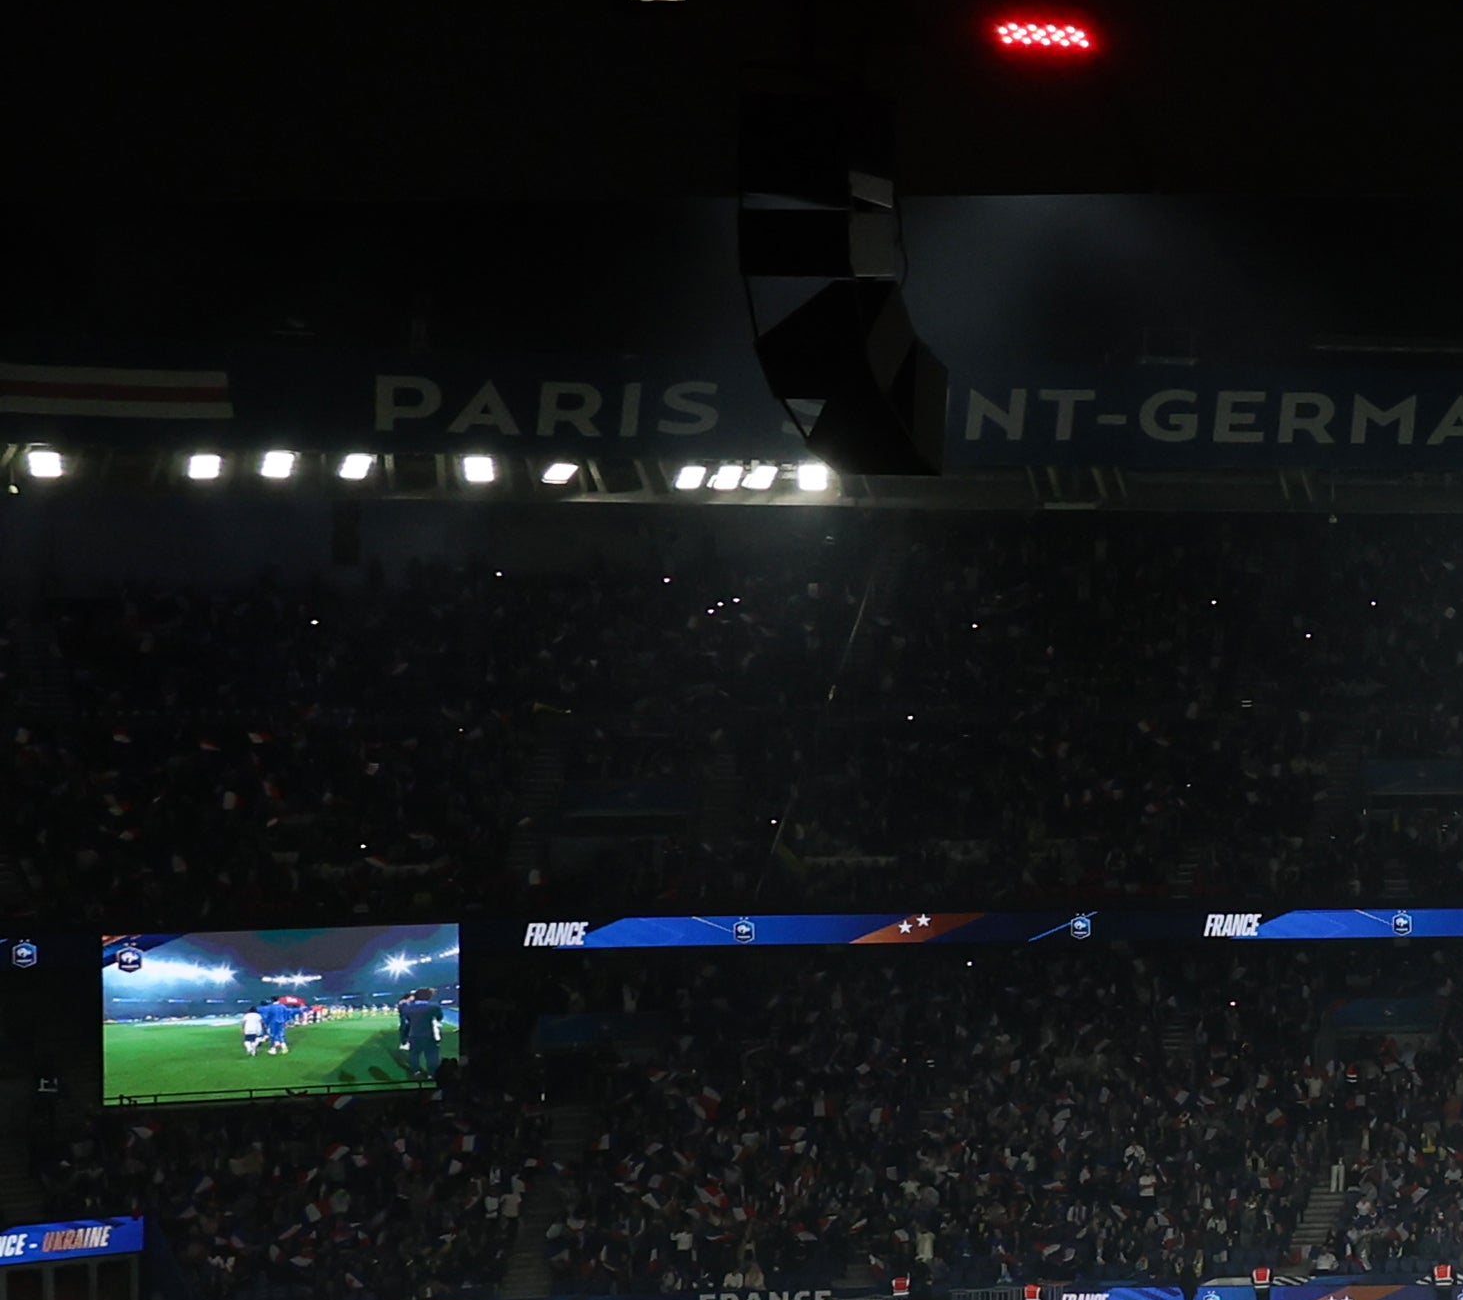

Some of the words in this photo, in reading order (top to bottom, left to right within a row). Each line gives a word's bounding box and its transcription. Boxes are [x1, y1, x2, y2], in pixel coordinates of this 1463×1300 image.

[376, 375, 719, 435] PARIS
[525, 922, 588, 946] FRANCE
[1204, 913, 1262, 936] FRANCE
[42, 1226, 112, 1253] UKRAINE
